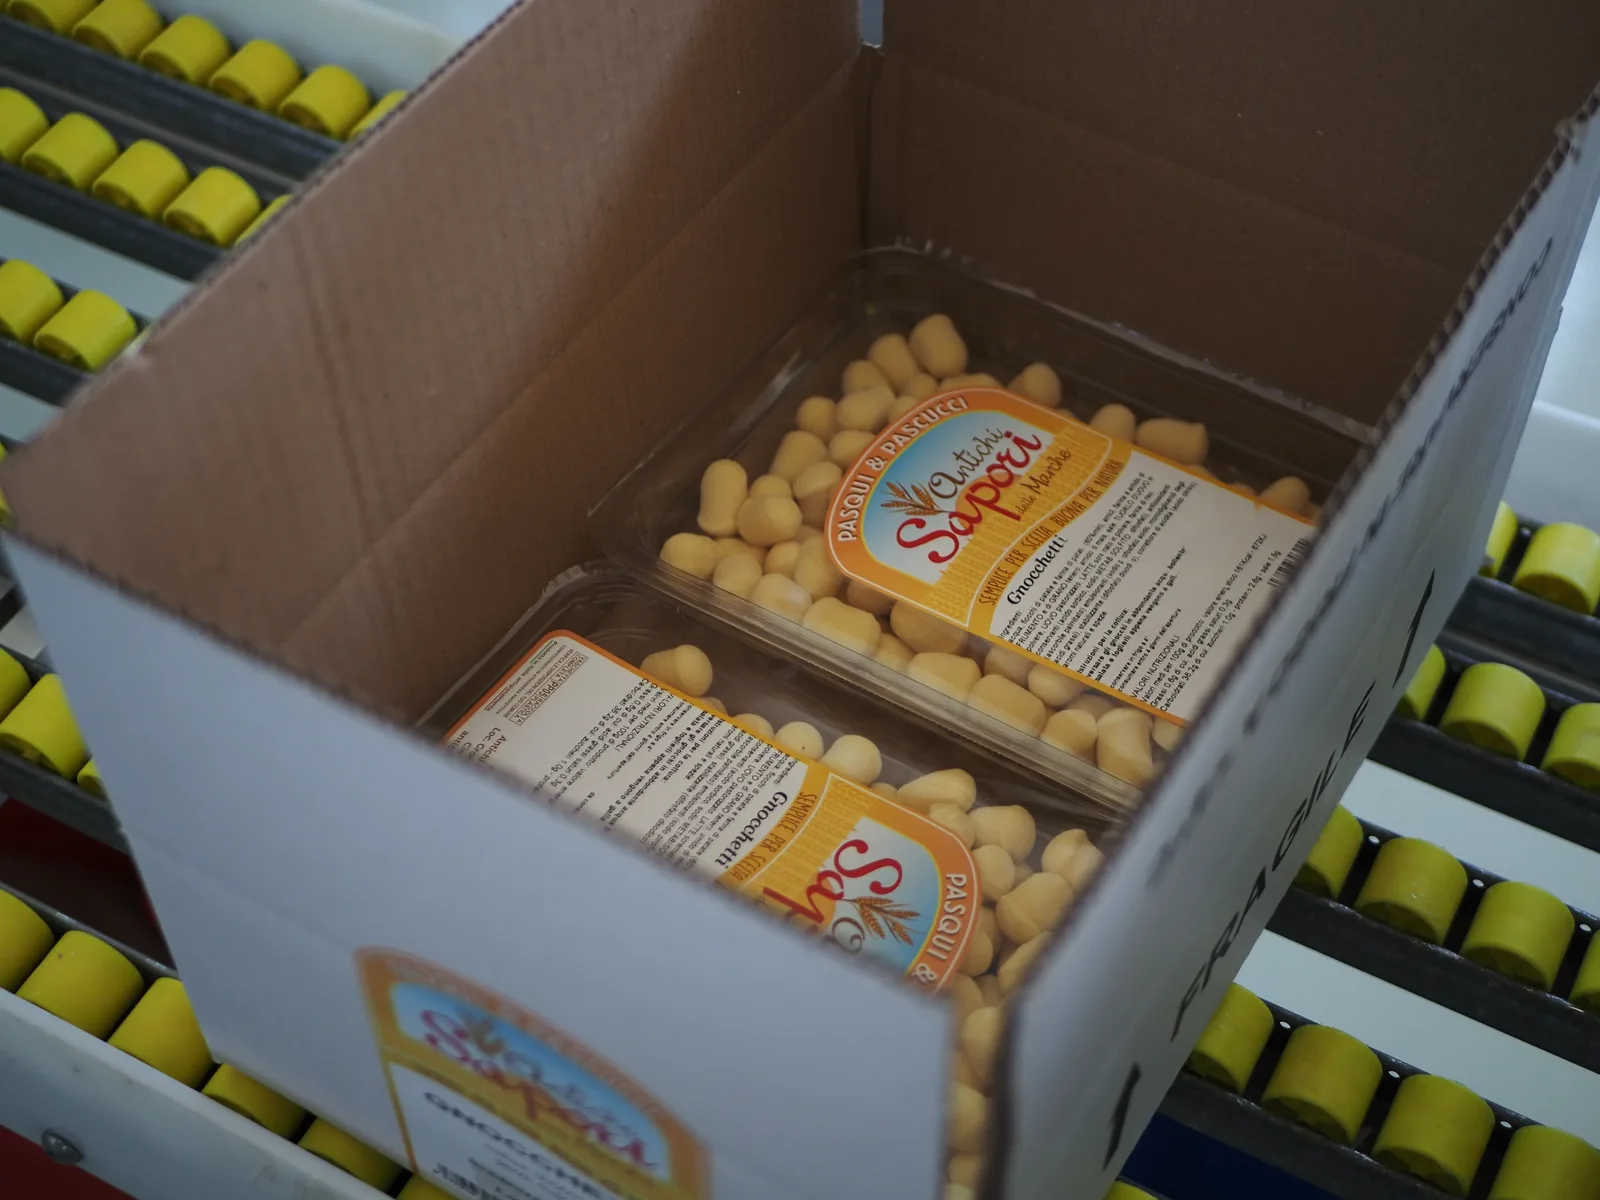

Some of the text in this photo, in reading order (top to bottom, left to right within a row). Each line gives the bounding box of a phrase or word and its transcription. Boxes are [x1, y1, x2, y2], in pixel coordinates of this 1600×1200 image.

[837, 396, 970, 542] PASQUI & PASCUCCI
[928, 428, 1004, 499] Antichi
[1017, 450, 1071, 516] delle Marche
[896, 430, 1042, 564] Sapori
[979, 567, 1013, 606] SEMPLICE
[1005, 549, 1028, 567] PER
[1050, 500, 1087, 527] BUONA
[1079, 486, 1102, 503] PER
[1094, 459, 1124, 490] NATURA
[1006, 534, 1069, 605] Gnocchetti
[1014, 613, 1044, 646] FRUMENTO
[1048, 582, 1068, 603] GRANO
[1077, 549, 1093, 565] amido
[1113, 499, 1133, 520] TUORLO
[1020, 606, 1037, 624] fiocchi
[1037, 584, 1056, 602] patate
[1054, 566, 1069, 580] farina
[1040, 610, 1058, 629] UOVO
[1054, 579, 1084, 612] pastorizzato,
[1078, 562, 1095, 580] LATTE
[1033, 624, 1060, 655] conservanti
[1056, 608, 1074, 626] (acido
[1084, 574, 1099, 588] sodio
[1042, 562, 1121, 660] (ascorbile palmitato) emulsionanti (sodio
[1051, 649, 1066, 663] acidi
[1076, 599, 1104, 629] stabilizzante
[1099, 576, 1123, 601] (difosfato
[1075, 606, 1129, 673] Istruzioni cottura:
[1086, 655, 1105, 677] versare
[1108, 624, 1129, 646] gnocchi
[1130, 586, 1157, 617] abbondante
[1093, 591, 1165, 681] salata toglierli appena vengono
[554, 653, 581, 677] COMPLETA
[557, 656, 585, 682] VASCHETTA
[1060, 631, 1091, 667] aromi naturali
[1109, 645, 1144, 688] conservare frigo
[1117, 665, 1138, 691] consumare
[1135, 652, 1148, 665] entro
[1147, 635, 1162, 649] giorni
[1129, 634, 1180, 698] VALORI NUTRIZIONALI
[1139, 600, 1217, 702] Valori medi 100g valore
[1149, 611, 1221, 707] Grassi acidi grassi saturi
[1159, 624, 1225, 711] Carboidrati zuccheri
[513, 695, 538, 718] PLASTICA
[516, 697, 542, 723] RACCOLTA
[538, 680, 559, 697] PP05
[564, 677, 649, 759] Carboidrati 36,2g zuccheri
[481, 727, 501, 743] Loc.
[564, 682, 658, 774] Grassi acidi grassi saturi
[566, 687, 667, 786] Valori medi 100g valore
[614, 691, 675, 751] VALORI NUTRIZIONALI
[632, 737, 649, 751] giorni
[650, 721, 665, 734] entro
[652, 730, 667, 742] frigo
[660, 717, 725, 783] Istruzioni cottura:
[704, 725, 739, 758] aromi naturali
[733, 729, 748, 742] acidi
[597, 709, 708, 822] salata toglierli appena vengono galla
[605, 750, 636, 779] dall'apertura
[606, 713, 715, 825] versare gnocchi abbondante acqua
[659, 733, 756, 834] (ascorbile palmitato) emulsionanti (sodio
[686, 761, 719, 793] stabilizzante
[687, 739, 765, 821] conservanti (acido sorbico, sodio
[735, 764, 756, 783] UOVO
[750, 748, 783, 781] FRUMENTO
[756, 770, 775, 788] fiocchi
[660, 791, 690, 819] (difosfato
[687, 815, 709, 835] LATTE
[703, 781, 739, 816] pastorizzato,
[717, 815, 735, 832] farina
[720, 790, 744, 813] GRANO
[734, 792, 755, 811] patate
[776, 791, 817, 834] SEMPLICE
[693, 836, 715, 856] patate
[714, 791, 788, 869] Gnocchetti
[760, 832, 786, 855] PER
[1170, 680, 1377, 1043] FRAGILE
[926, 872, 967, 961] PASQUI
